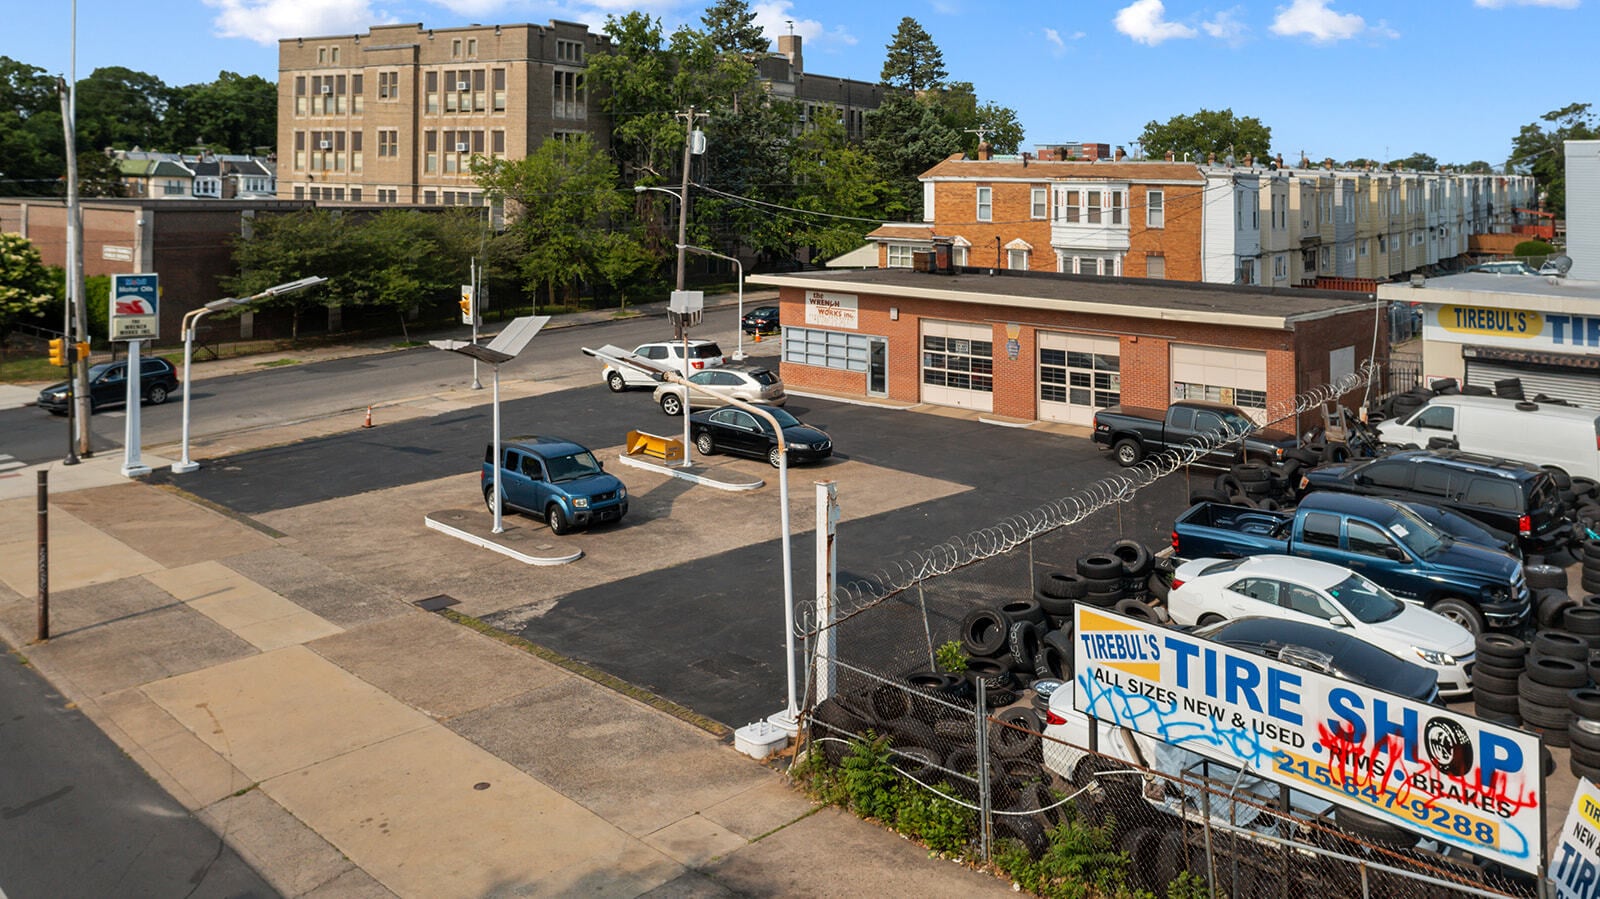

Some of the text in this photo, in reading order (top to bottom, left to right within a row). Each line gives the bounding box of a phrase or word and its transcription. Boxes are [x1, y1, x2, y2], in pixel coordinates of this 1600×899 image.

[809, 299, 840, 308] WRENCH
[818, 309, 842, 317] WORKS
[1454, 307, 1527, 333] TIREBUL'S
[1081, 634, 1160, 661] TIREBUL'S
[1165, 636, 1303, 726] TIRE
[1094, 668, 1512, 819] ALL SIZES NEW & USED RIMS BRAKES
[1277, 751, 1494, 844] 215-847-9288
[1573, 821, 1597, 849] NEW
